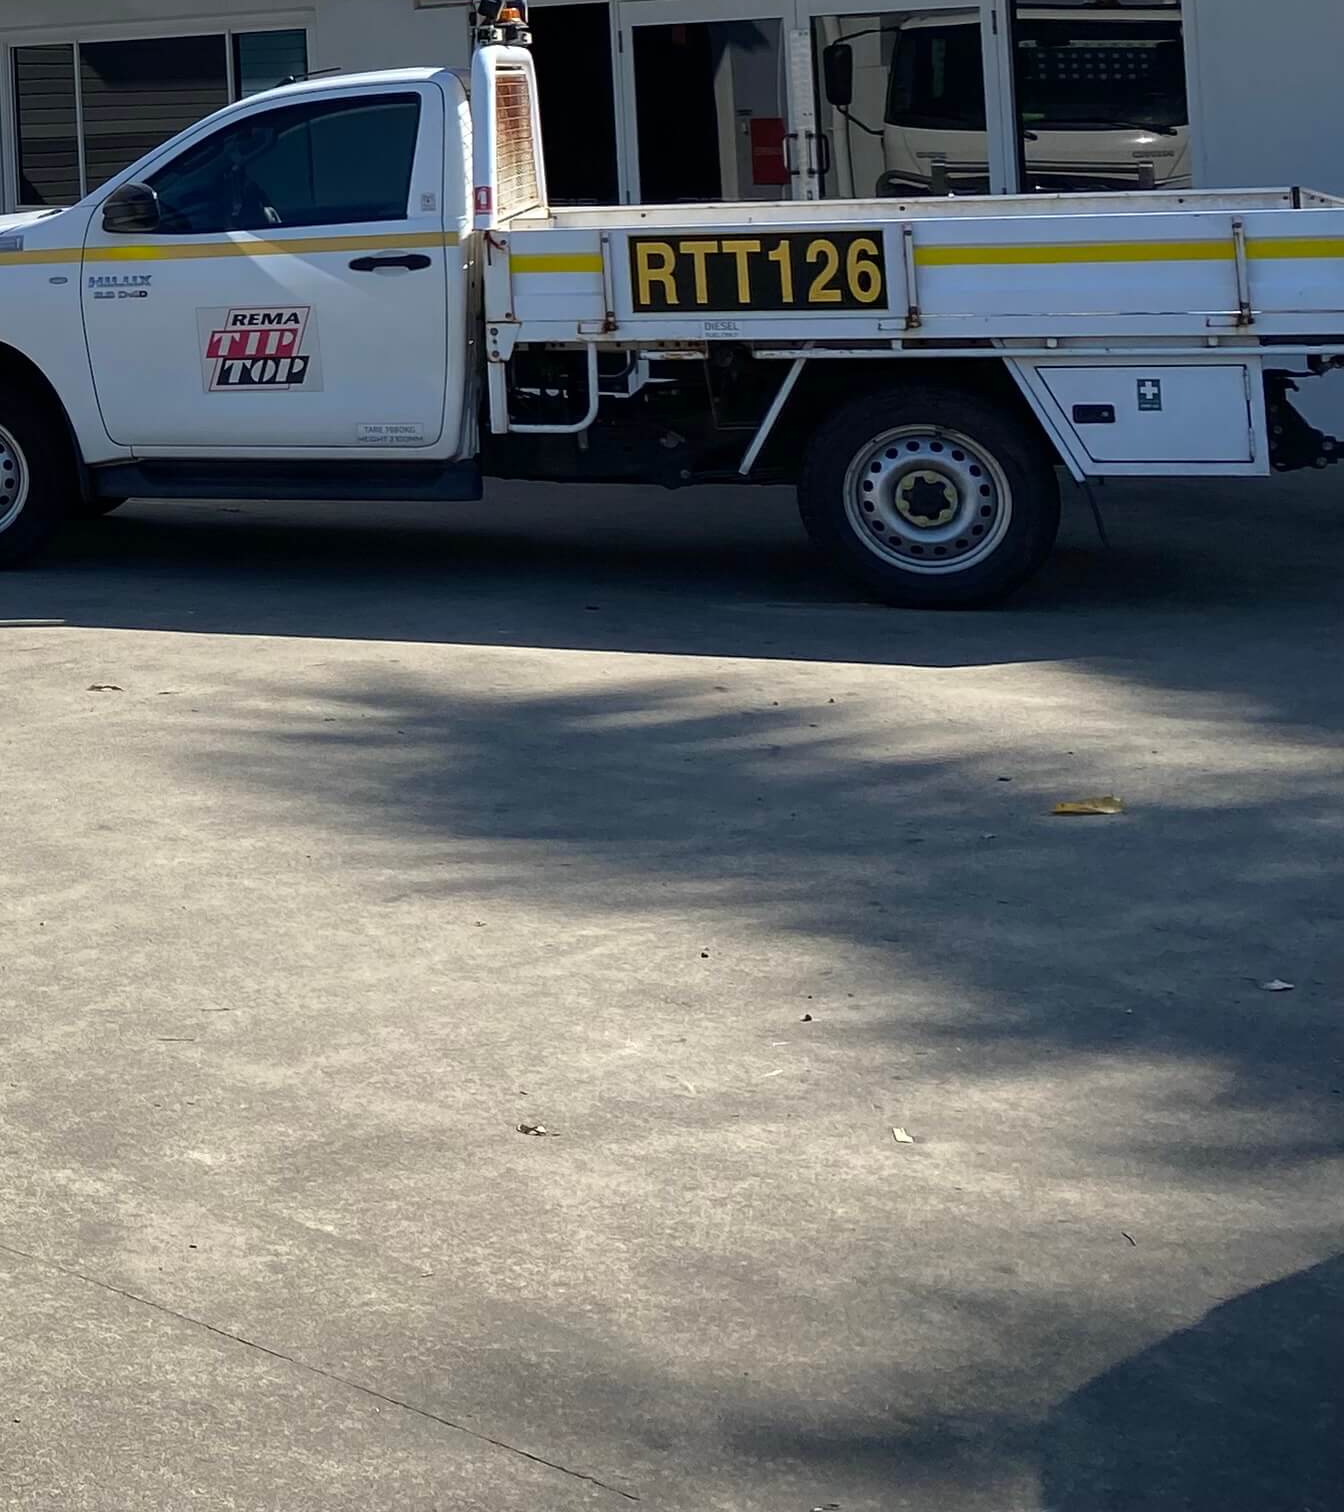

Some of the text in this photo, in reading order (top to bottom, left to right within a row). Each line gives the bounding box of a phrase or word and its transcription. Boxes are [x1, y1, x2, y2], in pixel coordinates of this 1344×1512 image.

[88, 274, 153, 288] HILUX
[635, 239, 882, 306] RTT126
[231, 312, 300, 326] REMA
[704, 321, 740, 331] DIESEL
[212, 330, 295, 356] TIP
[223, 358, 305, 383] TOP
